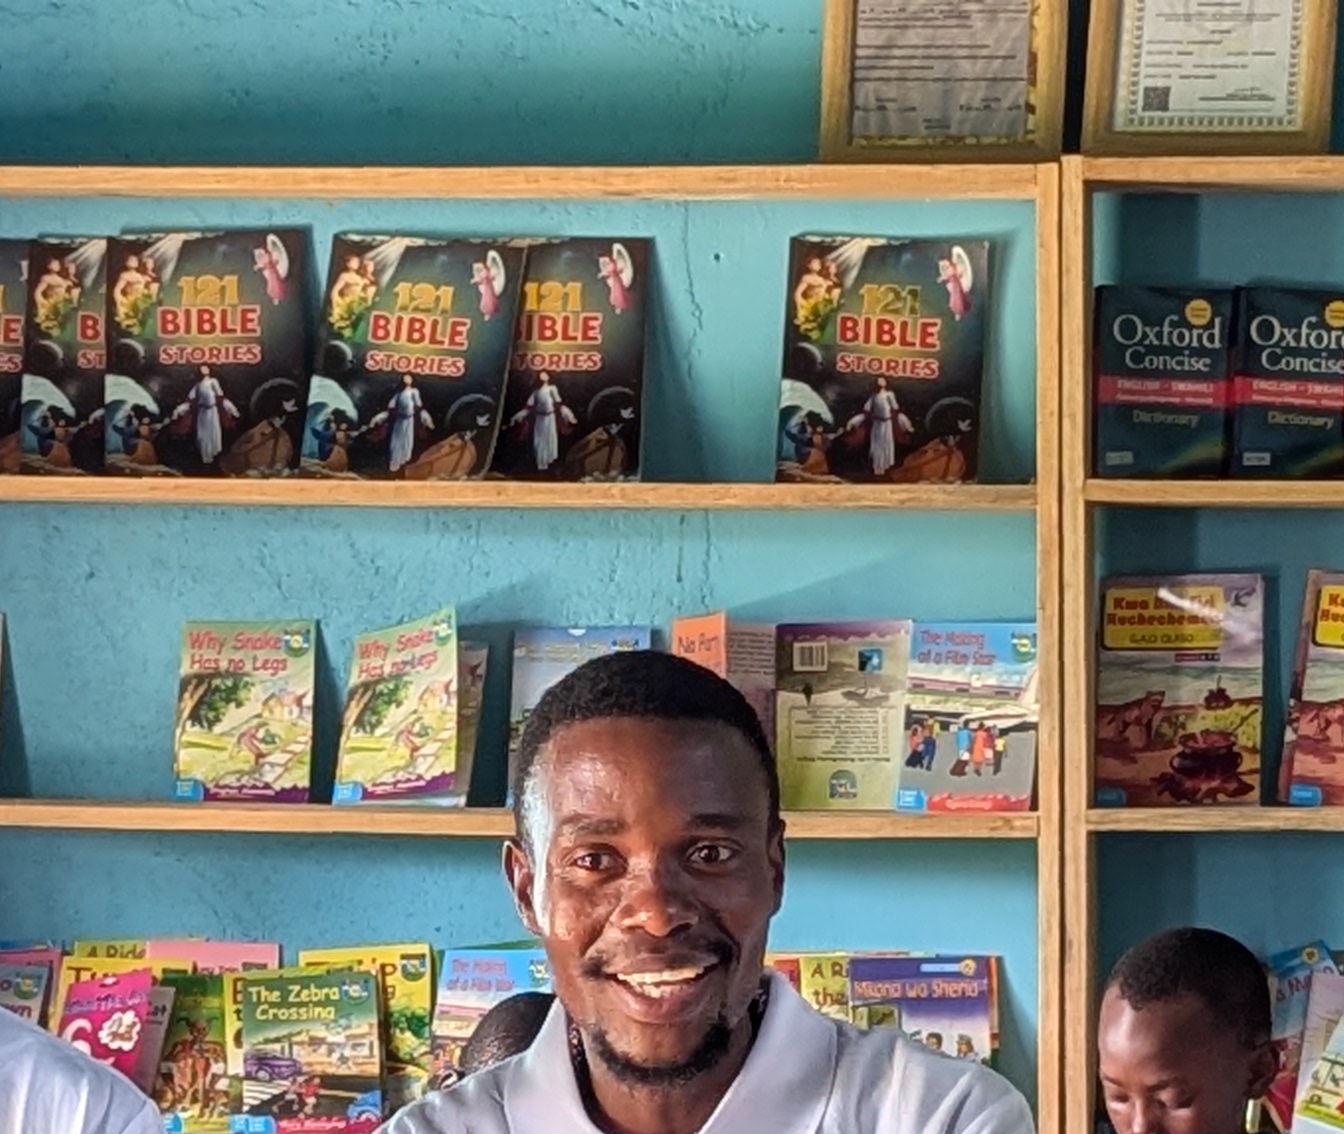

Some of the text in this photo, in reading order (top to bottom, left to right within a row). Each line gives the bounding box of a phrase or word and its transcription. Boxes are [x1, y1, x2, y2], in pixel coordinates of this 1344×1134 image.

[178, 275, 239, 305] 121
[392, 281, 454, 314] 121
[523, 281, 583, 312] 121
[859, 284, 921, 317] 121
[157, 306, 261, 337] BIBLE
[367, 311, 471, 349] BIBLE
[836, 315, 942, 349] BIBLE
[1112, 314, 1222, 349] Oxford
[159, 343, 262, 365] STORIES
[365, 350, 466, 377] STORIES
[516, 351, 601, 372] TORIES
[836, 352, 940, 378] STORIES
[1125, 348, 1211, 372] Concise
[1133, 410, 1199, 427] Dictionary
[1268, 411, 1334, 430] Dictionary
[1113, 597, 1149, 610] Kwa
[189, 630, 282, 654] Why Snake
[358, 628, 433, 661] Why Snake
[190, 654, 287, 675] Has no Legs
[358, 663, 385, 679] Has
[407, 648, 438, 670] Legs
[87, 945, 98, 958] A
[812, 963, 824, 978] A
[248, 984, 340, 1002] The Zebra
[256, 1004, 336, 1022] Crossing
